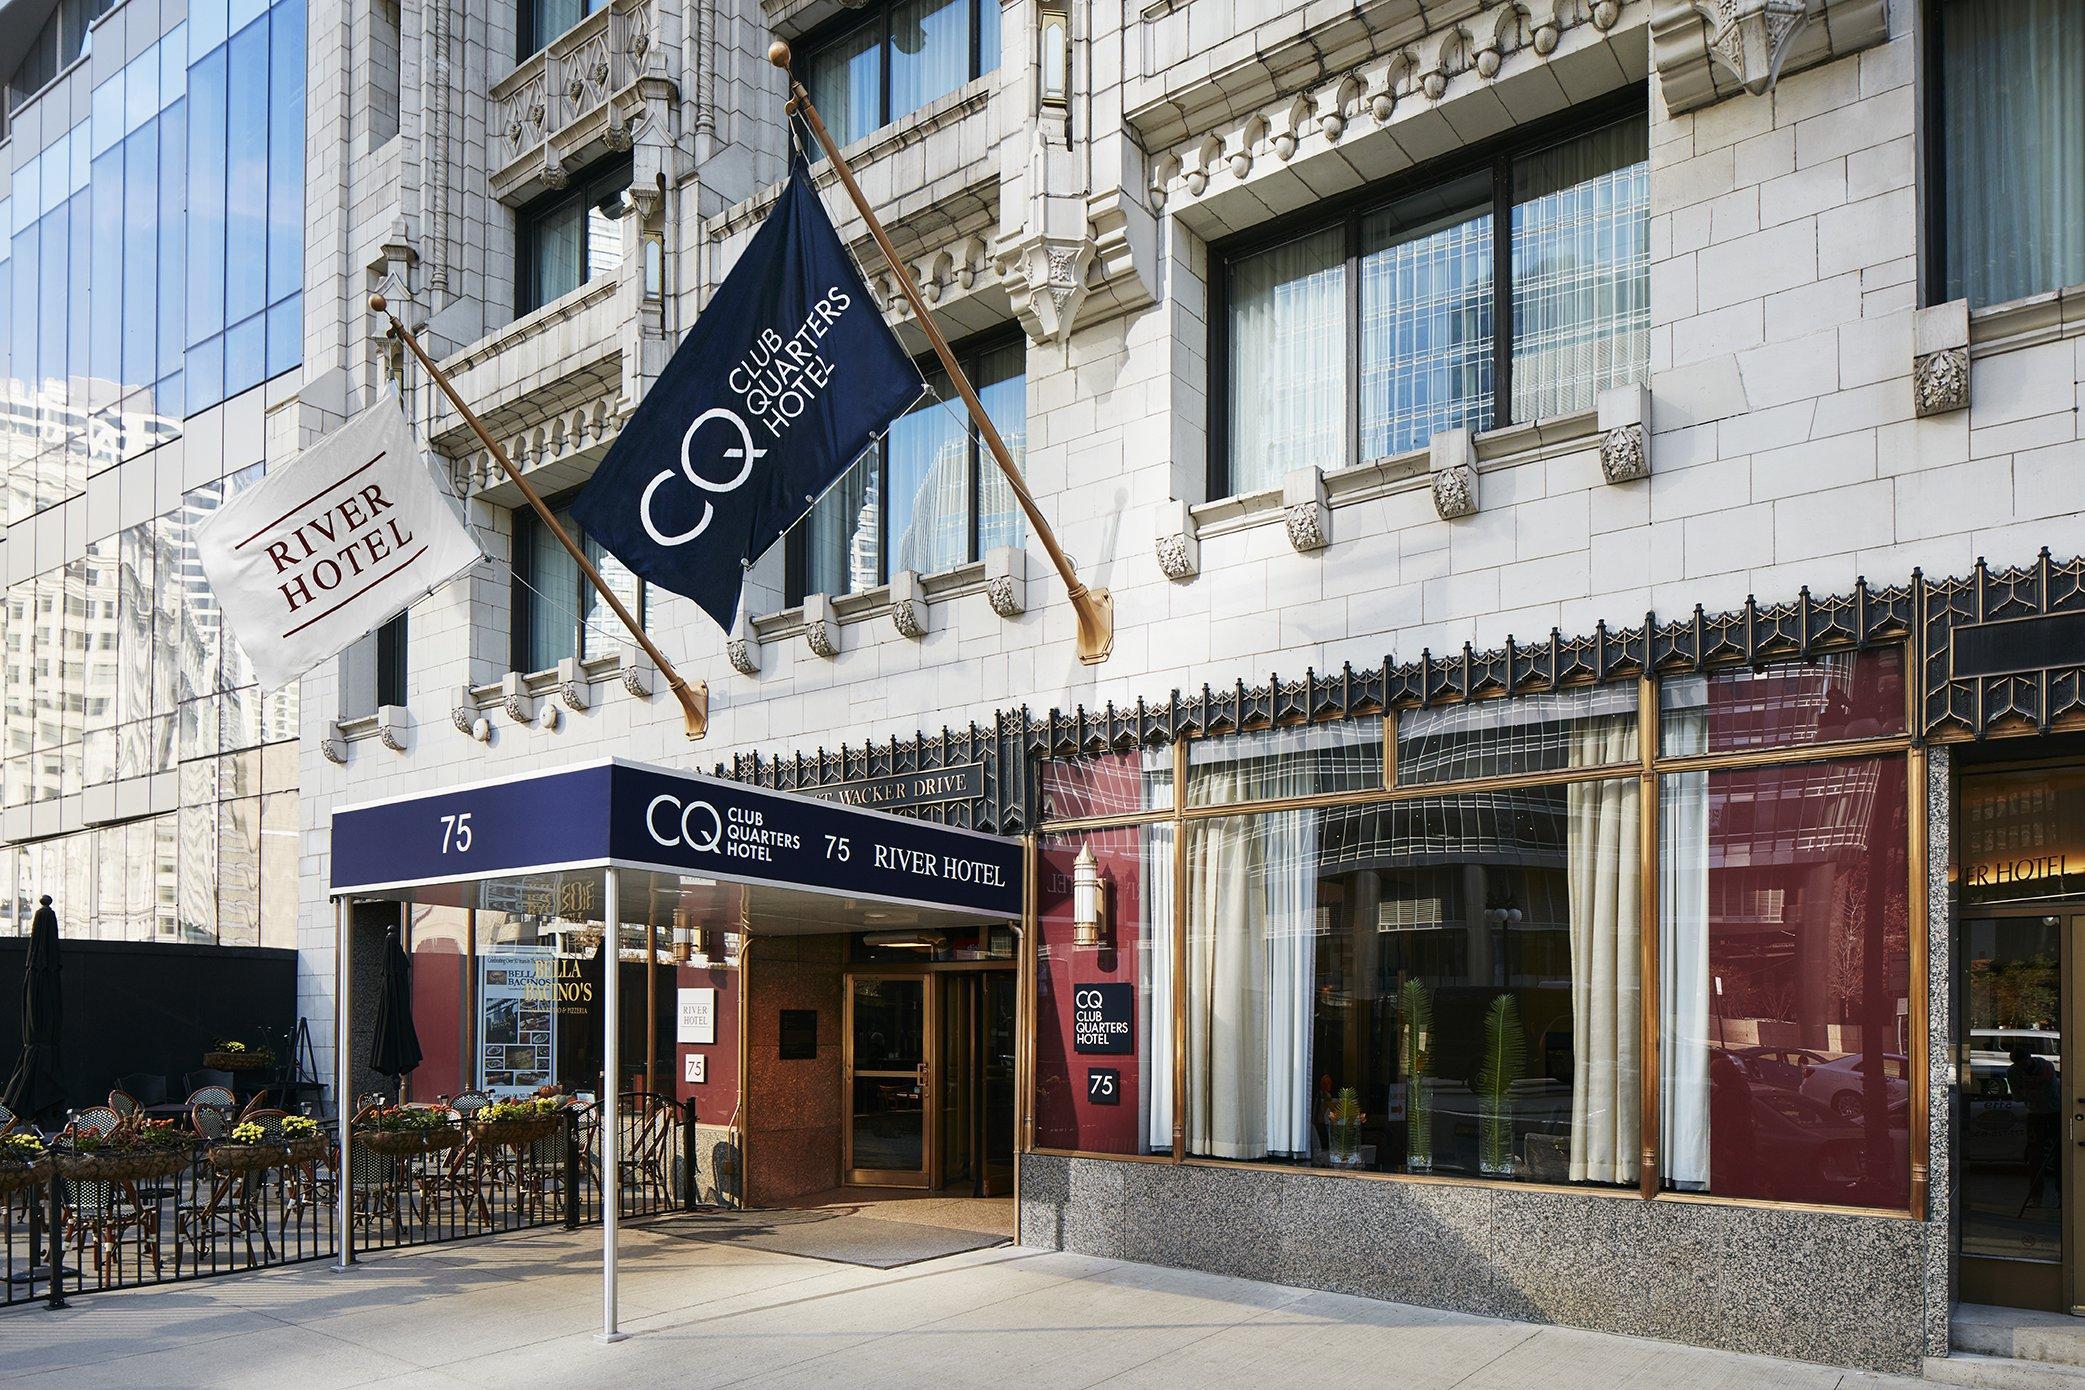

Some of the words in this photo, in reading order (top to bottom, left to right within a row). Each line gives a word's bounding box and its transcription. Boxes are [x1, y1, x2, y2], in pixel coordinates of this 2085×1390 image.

[728, 328, 783, 394] CLUB
[746, 286, 851, 416] QUARTERS
[762, 356, 835, 438] HOTEL
[640, 408, 768, 546] CQ
[264, 484, 394, 575] RIVER
[278, 518, 413, 612] HOTEL
[839, 784, 907, 805] WACKER
[914, 774, 967, 797] DRIVE
[646, 794, 722, 854] CQ
[727, 807, 763, 827] CLUB
[440, 812, 472, 854] 75
[727, 826, 800, 850] QUARTERS
[727, 841, 772, 862] HOTEL
[824, 835, 850, 862] 75
[874, 844, 938, 877] RIVER
[943, 856, 1006, 888] HOTEL
[1996, 855, 2072, 884] HOTEL
[535, 960, 582, 978] BELLA
[524, 983, 592, 1001] BACINO'S
[1076, 990, 1103, 1009] CQ
[683, 1006, 707, 1014] RIVER
[684, 1017, 708, 1025] HOTEL
[1076, 1011, 1102, 1022] CLUB
[1076, 1022, 1129, 1034] QUARTERS
[1077, 1034, 1109, 1045] HOTEL
[688, 1061, 702, 1076] 75
[1091, 1075, 1113, 1095] 75
